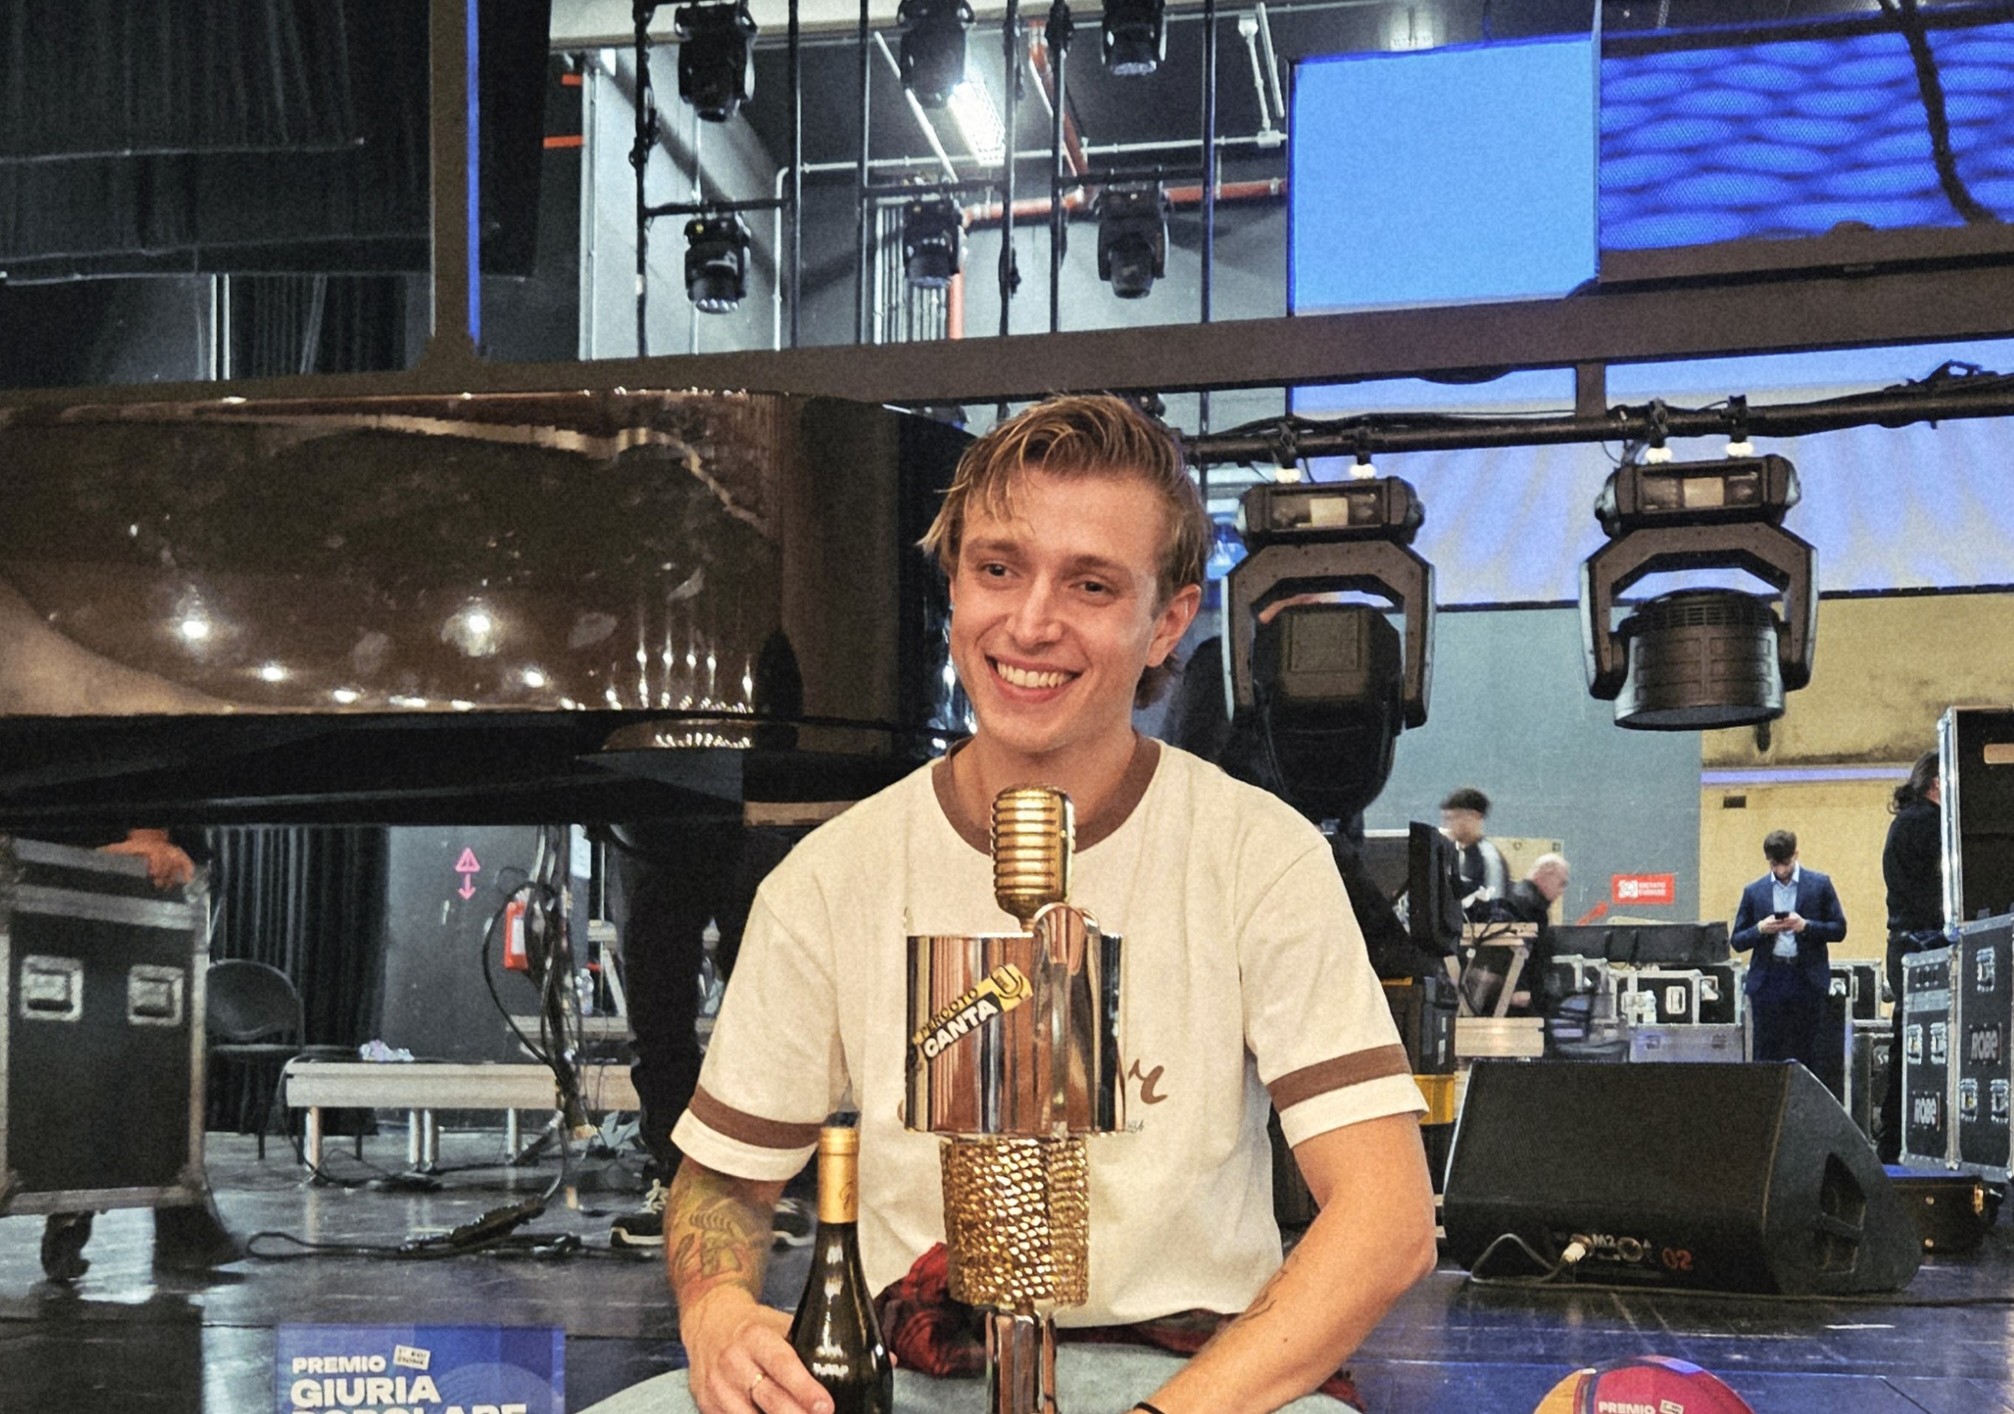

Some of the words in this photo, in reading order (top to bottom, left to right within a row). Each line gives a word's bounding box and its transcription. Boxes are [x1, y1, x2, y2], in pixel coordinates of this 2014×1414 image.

[923, 999, 999, 1058] CANTA
[292, 1355, 387, 1374] PREMIO
[291, 1375, 442, 1408] GIURIA
[1598, 1401, 1656, 1414] PREMIO
